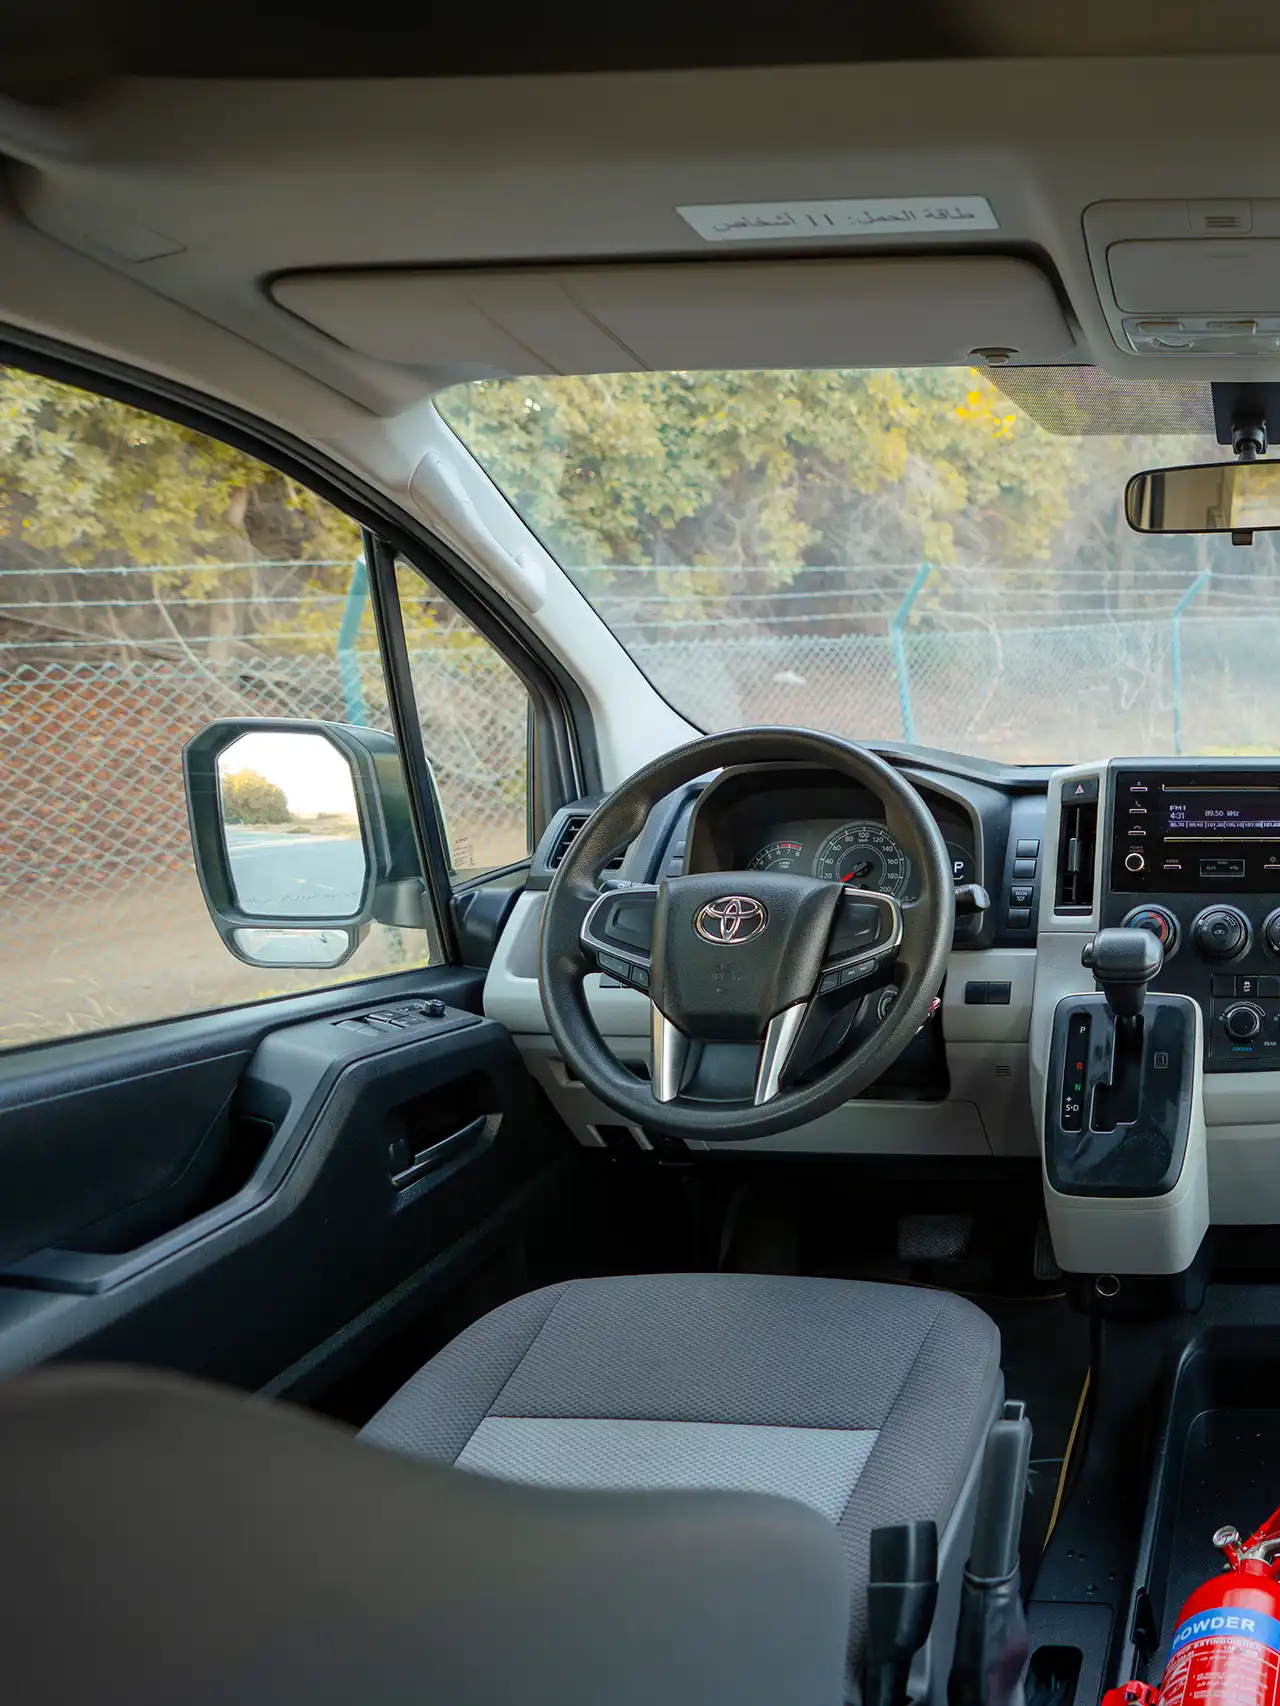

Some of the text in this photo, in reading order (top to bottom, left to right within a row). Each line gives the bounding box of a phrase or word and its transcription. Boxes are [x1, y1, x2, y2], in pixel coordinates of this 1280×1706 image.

[954, 861, 964, 873] P
[1079, 1026, 1086, 1034] P
[1076, 1062, 1083, 1070] R
[1172, 1616, 1256, 1650] POWDER
